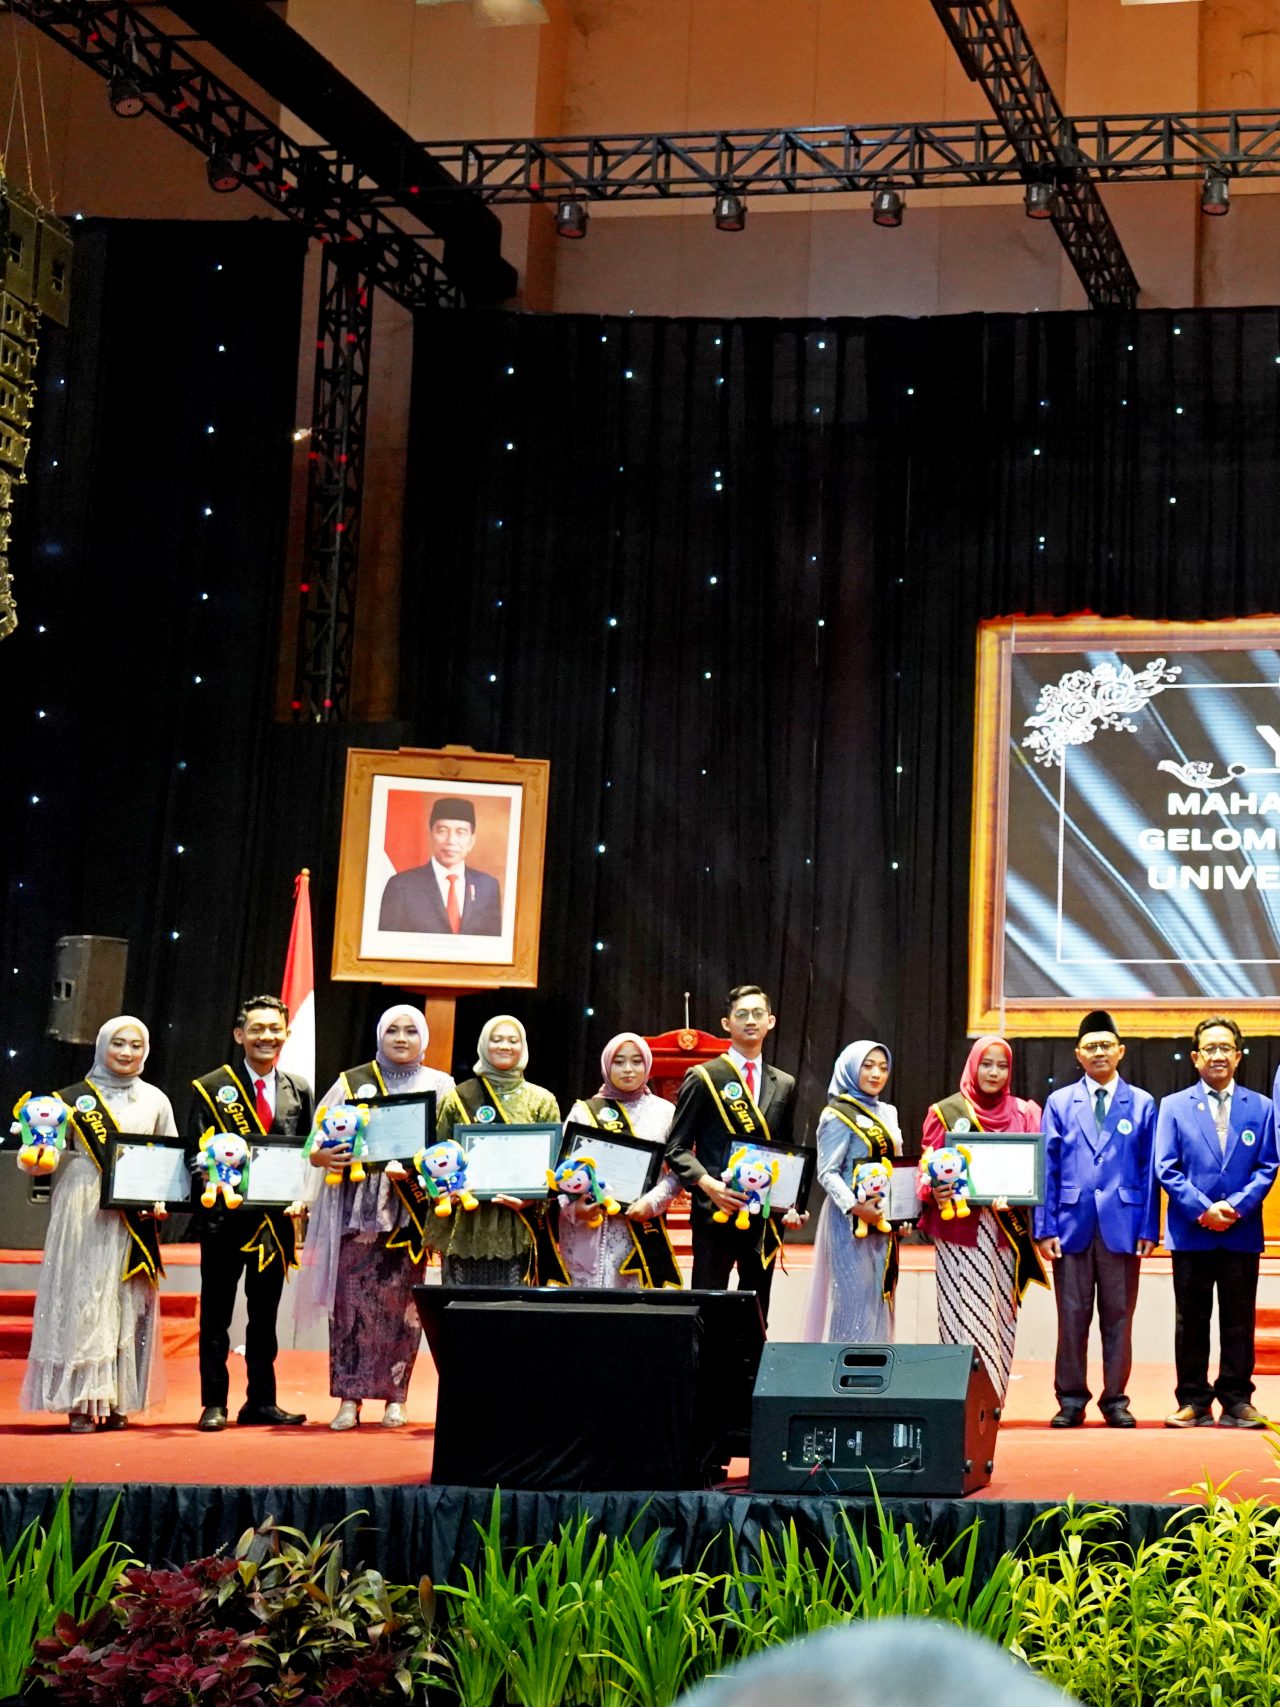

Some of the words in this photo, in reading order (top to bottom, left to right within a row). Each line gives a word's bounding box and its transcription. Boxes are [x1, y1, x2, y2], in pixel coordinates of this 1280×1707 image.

[224, 1102, 251, 1135] Guru
[730, 1100, 755, 1133] Guru
[867, 1125, 888, 1155] Guru
